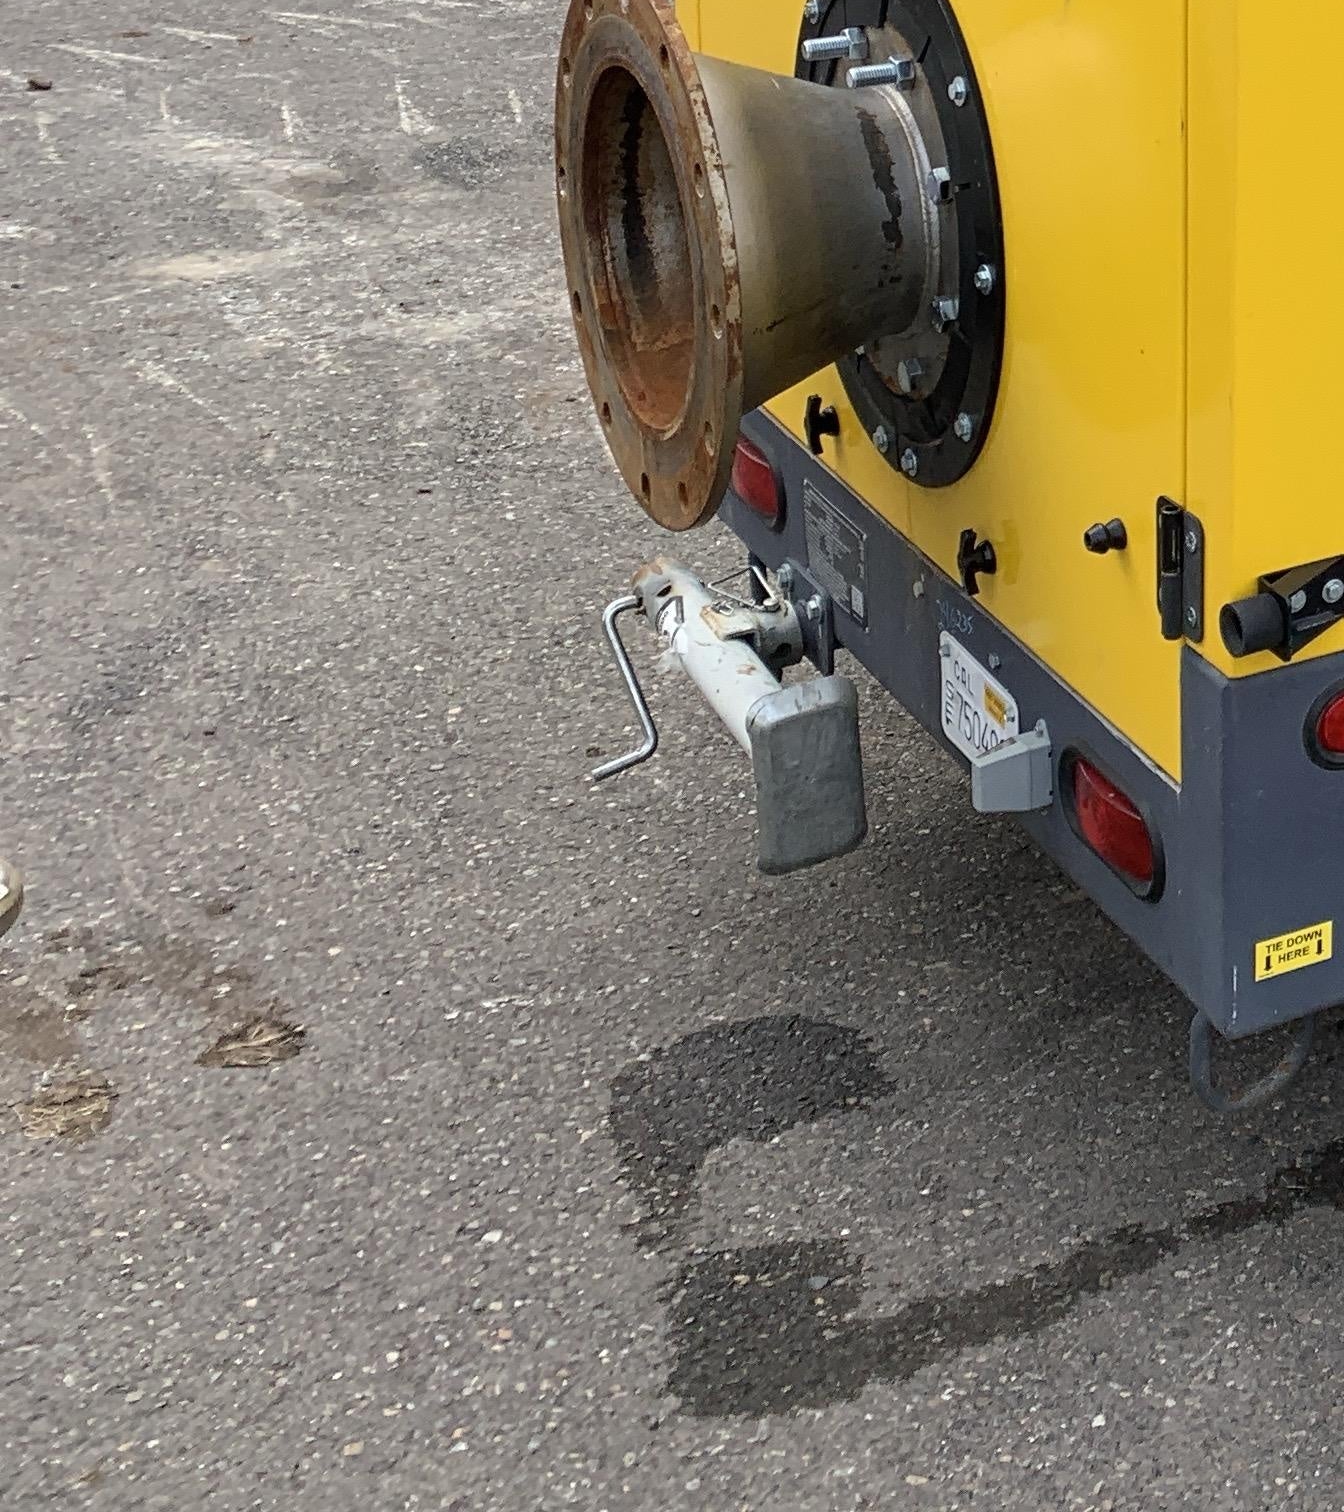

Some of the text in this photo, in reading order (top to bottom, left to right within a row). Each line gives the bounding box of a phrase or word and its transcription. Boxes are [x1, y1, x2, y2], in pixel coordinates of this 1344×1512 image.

[953, 660, 975, 696] CAL
[1265, 929, 1322, 954] TIE DOWN
[1278, 945, 1310, 964] HERE
